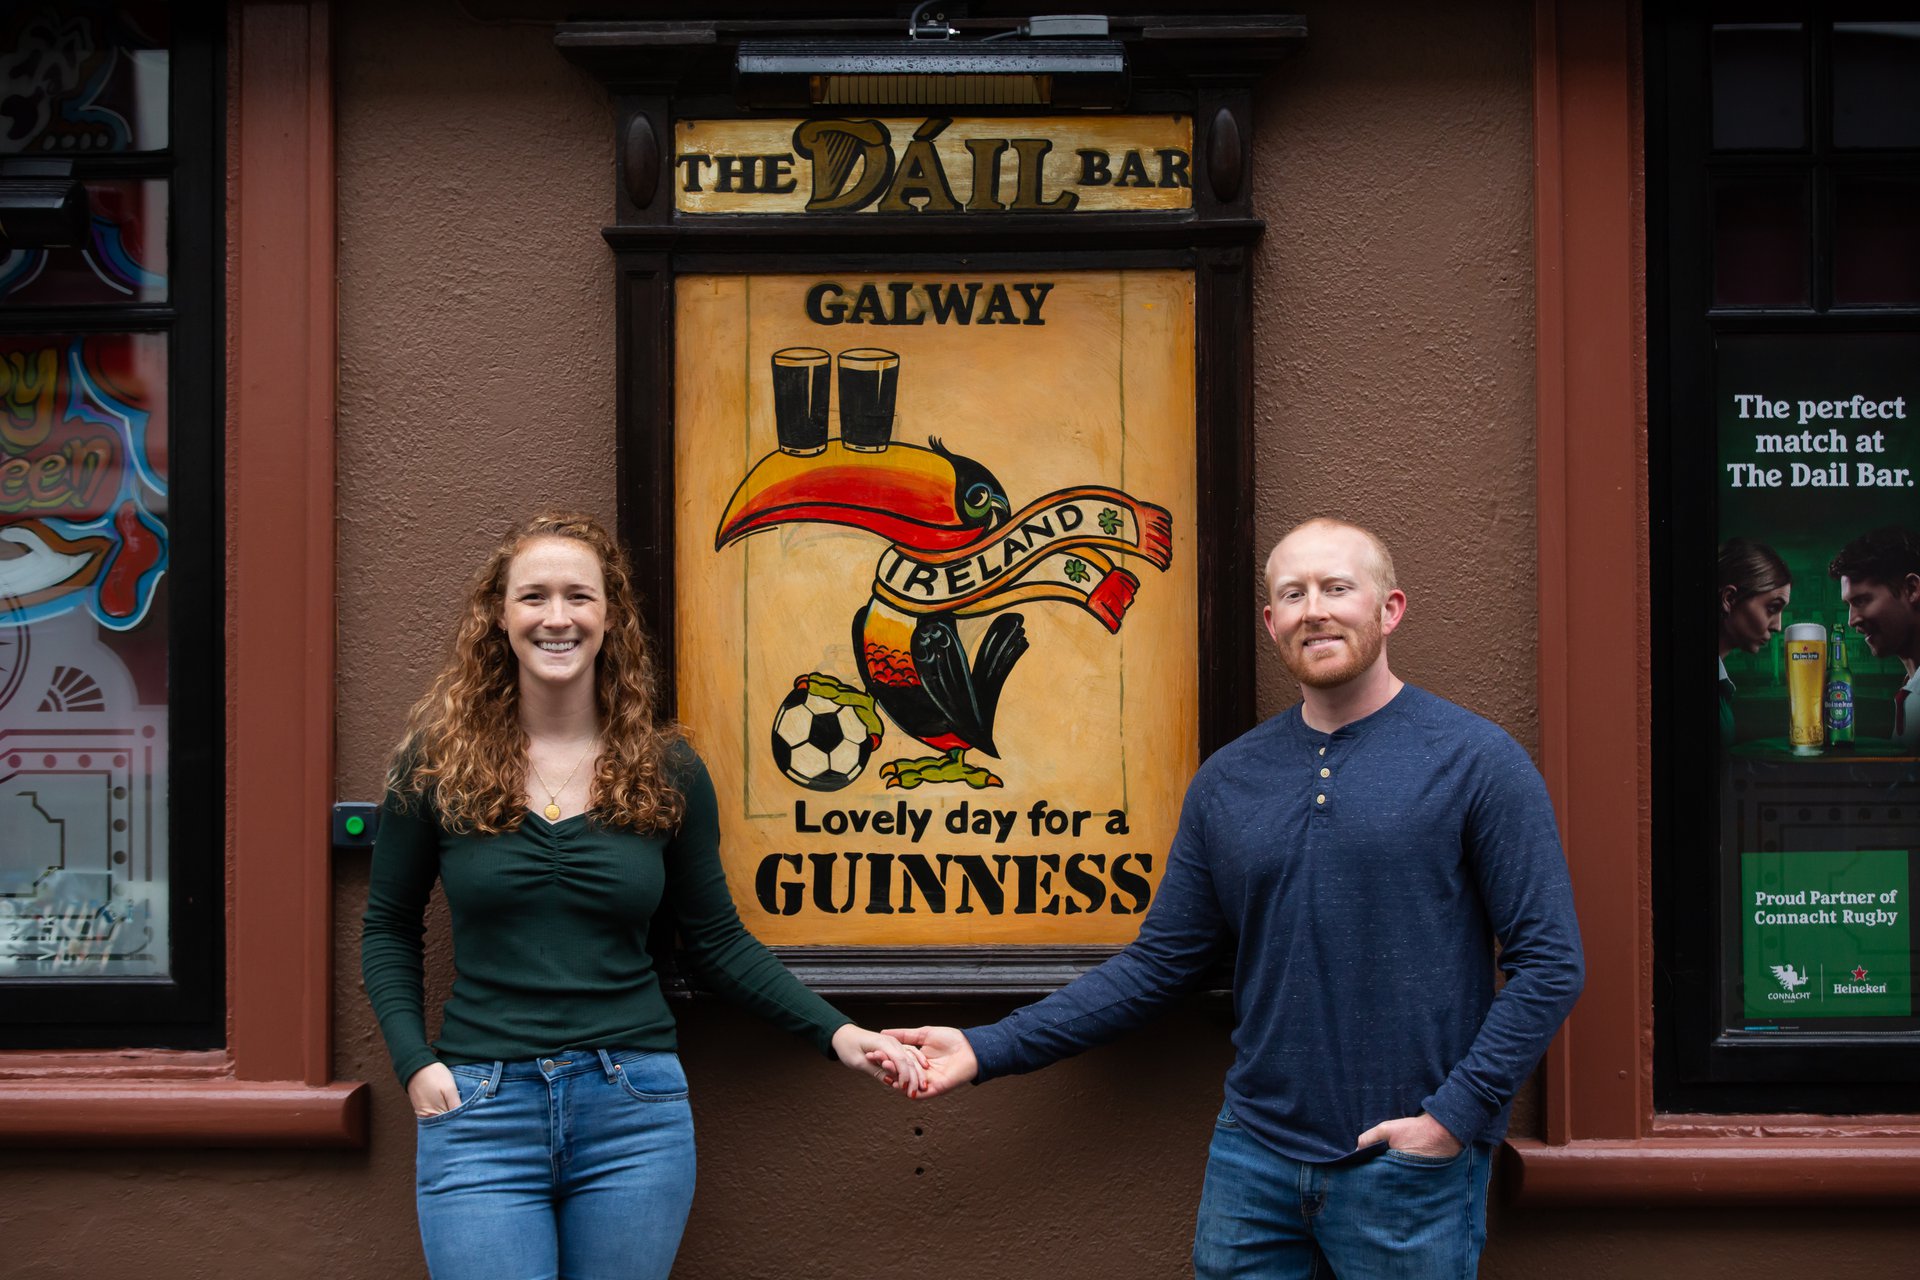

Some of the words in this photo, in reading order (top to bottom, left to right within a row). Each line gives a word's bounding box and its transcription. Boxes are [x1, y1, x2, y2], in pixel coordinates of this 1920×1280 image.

[676, 152, 797, 193] THE
[790, 115, 1079, 213] DÁIL
[1076, 148, 1193, 189] BAR
[806, 282, 1054, 326] GALWAY
[1734, 394, 1790, 419] The
[1797, 395, 1907, 424] perfect
[1755, 429, 1848, 453] match
[1855, 430, 1885, 453] at
[1726, 463, 1782, 487] The
[1790, 462, 1849, 487] Dail
[1856, 463, 1914, 487] Bar.
[885, 504, 1083, 596] IRELAND
[795, 799, 932, 843] Lovely
[945, 799, 1018, 843] day
[1027, 799, 1092, 837] for
[1105, 808, 1129, 835] a
[754, 851, 1154, 916] GUINNESS
[1755, 890, 1806, 906] Proud
[1809, 890, 1876, 906] Partner
[1880, 889, 1898, 904] of
[1754, 909, 1837, 925] Connacht
[1842, 909, 1898, 927] Rugby
[1767, 991, 1811, 1001] CONNACHT
[1833, 983, 1887, 994] Heineken
